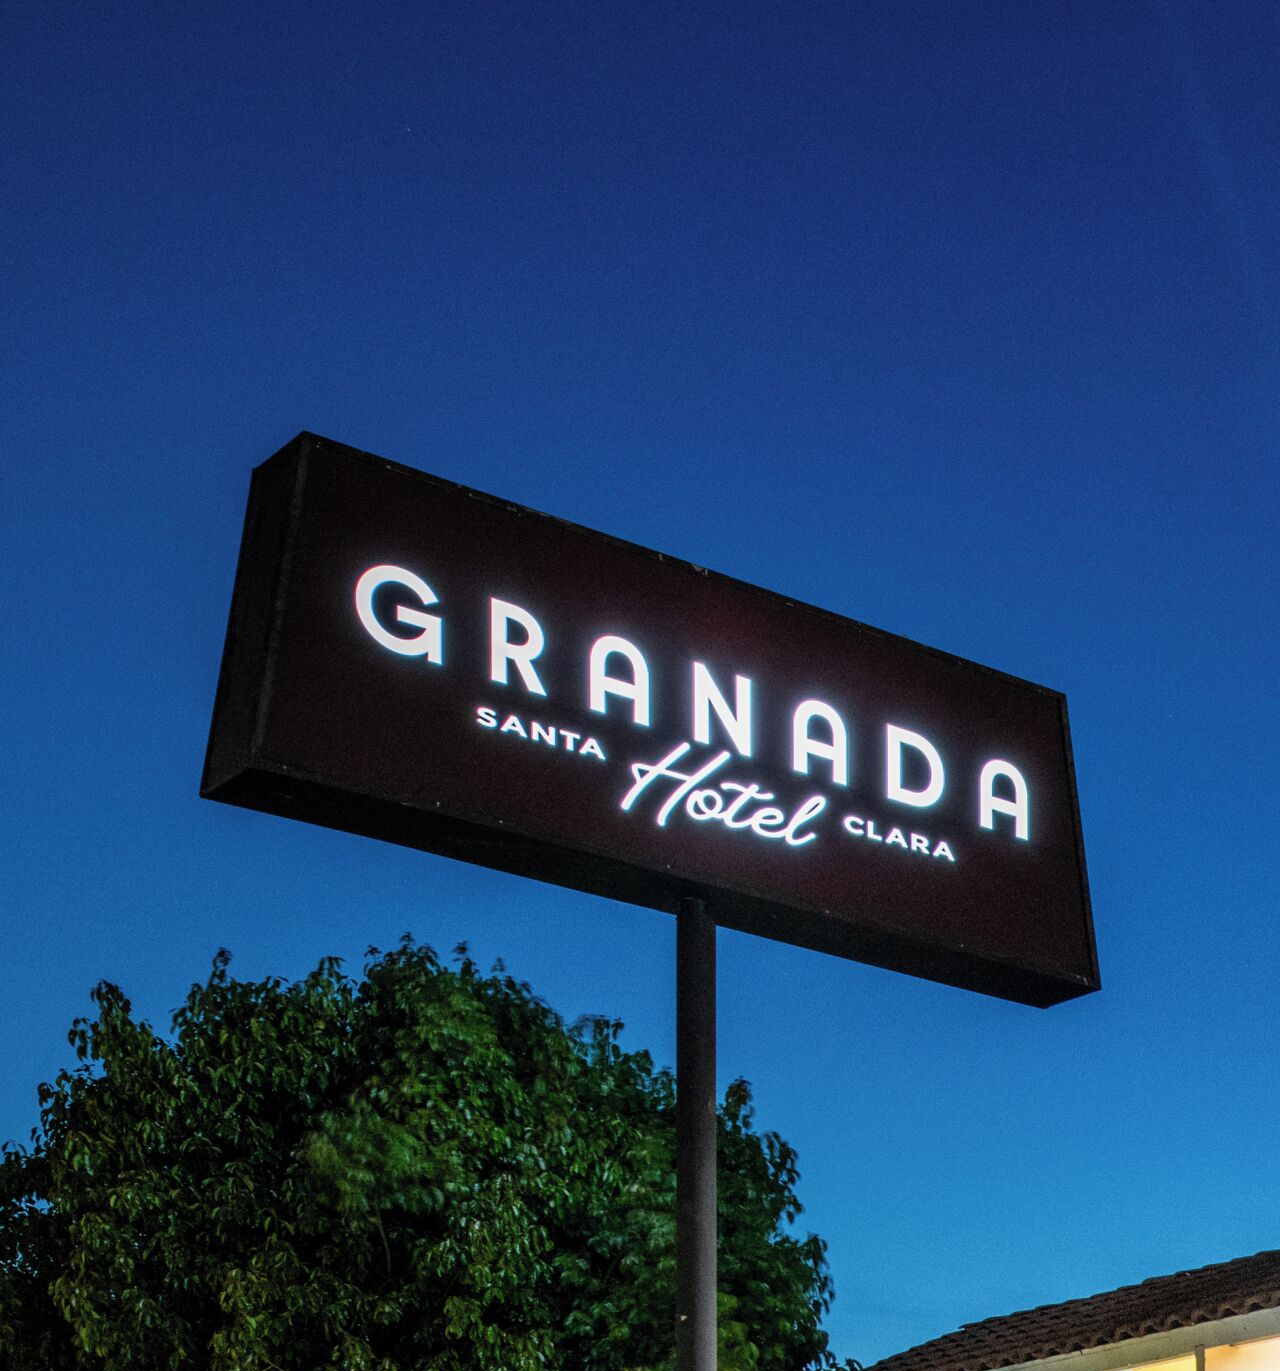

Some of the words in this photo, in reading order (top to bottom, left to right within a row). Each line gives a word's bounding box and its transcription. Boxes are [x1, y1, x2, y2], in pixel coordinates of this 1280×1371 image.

[354, 565, 1029, 841] GRANADA
[476, 706, 606, 760] SANTA
[620, 741, 827, 846] Hotel
[842, 815, 956, 862] CLARA
